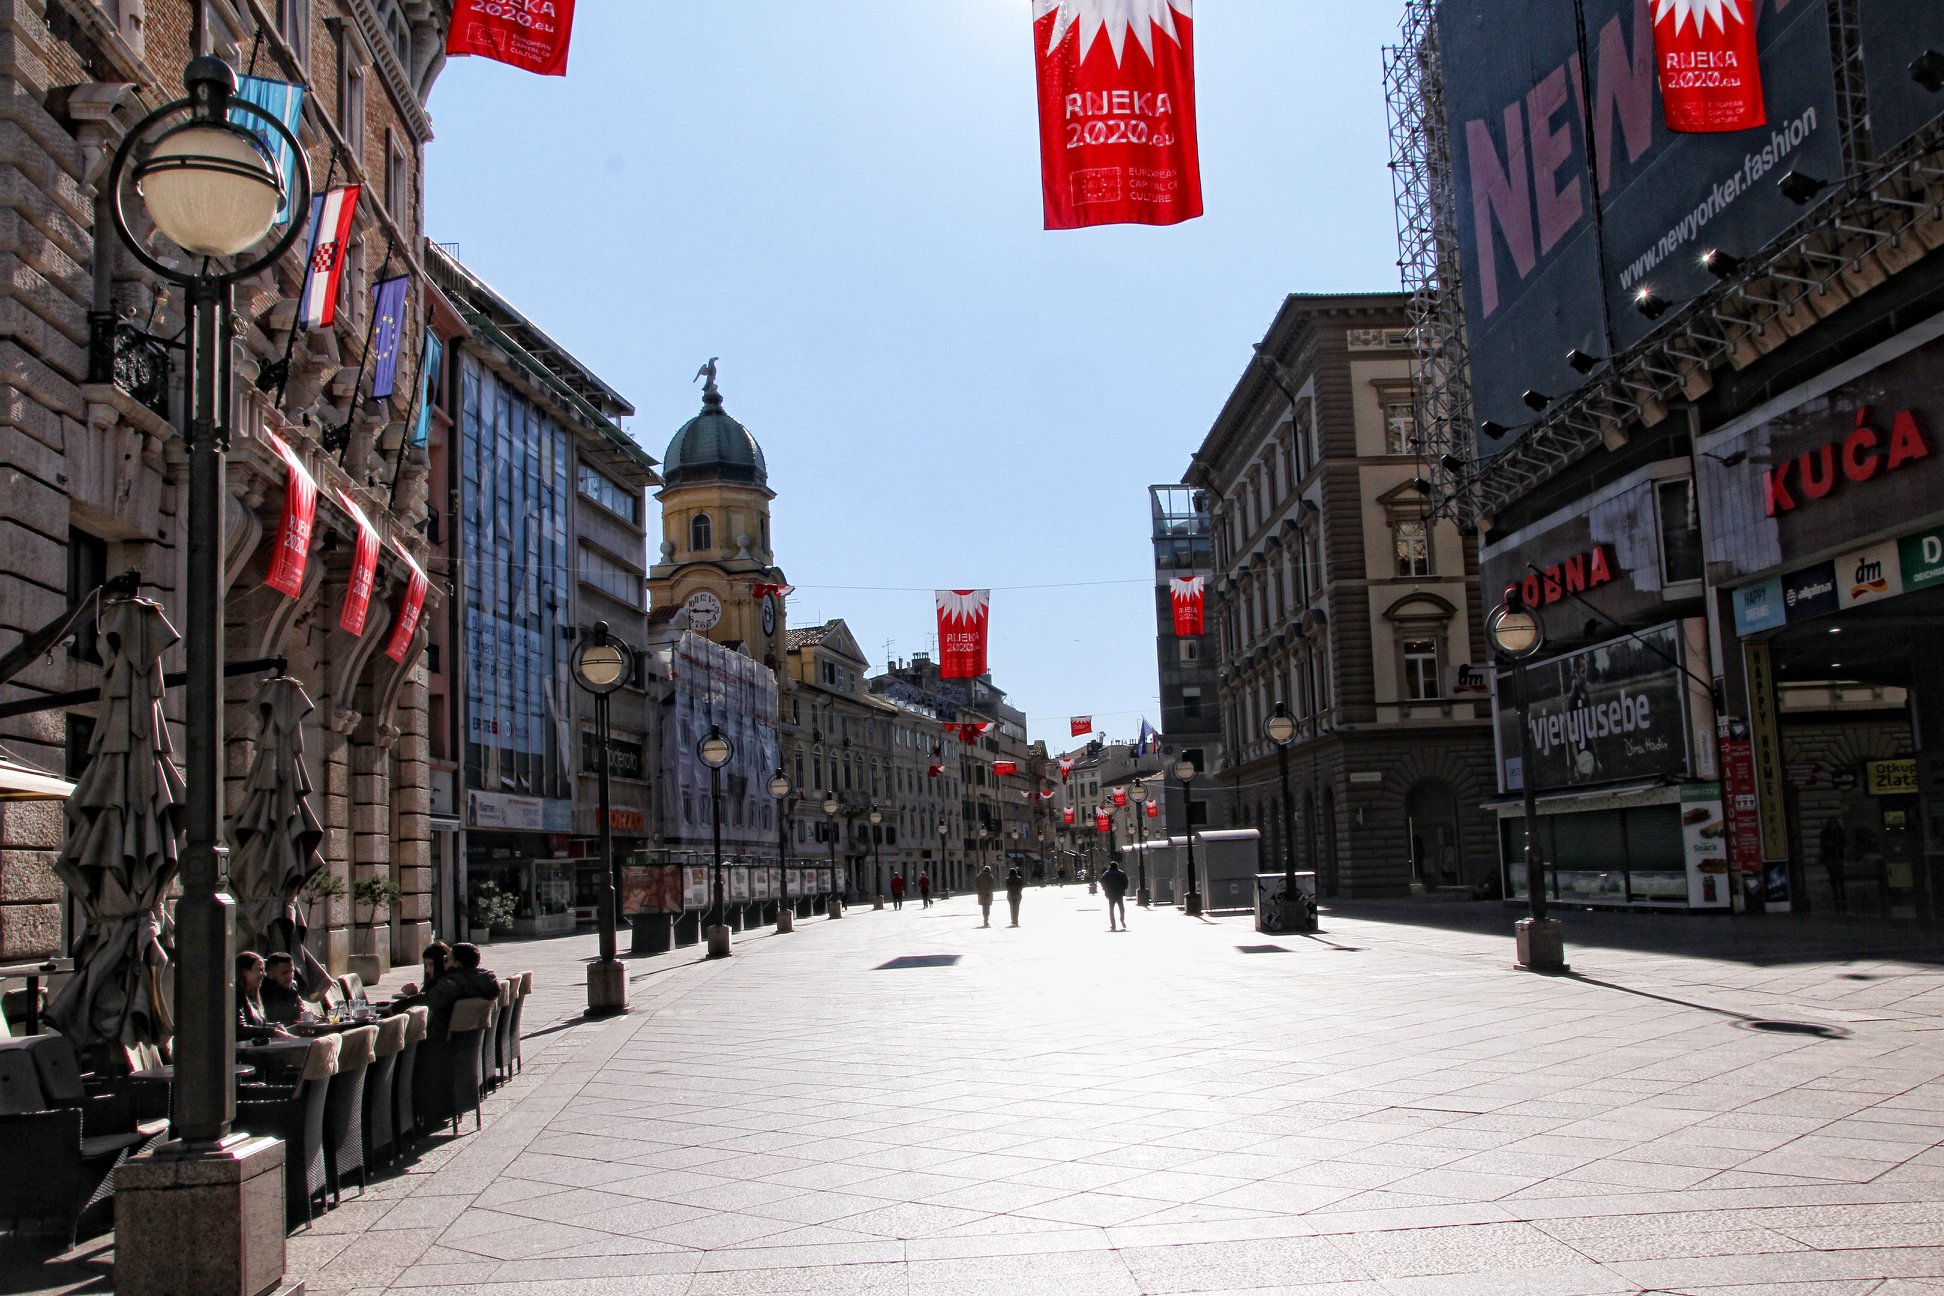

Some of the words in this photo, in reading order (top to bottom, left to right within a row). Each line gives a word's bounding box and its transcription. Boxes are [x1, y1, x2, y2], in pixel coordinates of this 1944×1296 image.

[1666, 50, 1739, 69] RIJEKA
[1667, 70, 1741, 88] 2020.eu
[1065, 90, 1172, 119] RIJEKA
[1066, 119, 1175, 149] 2020.eu
[1128, 167, 1177, 179] EUROPEAN
[1129, 191, 1172, 203] CULTURE
[1620, 105, 1818, 291] www.newyorker.fashion
[1763, 405, 1928, 517] KUĆA
[1922, 535, 1942, 563] D
[1855, 556, 1881, 584] dm
[700, 593, 707, 602] 12
[1744, 585, 1766, 608] HAPPY
[1797, 581, 1833, 600] alpina
[688, 599, 695, 608] 10
[714, 606, 720, 614] 3
[695, 620, 700, 628] 7
[700, 621, 706, 629] 6
[472, 716, 491, 734] ERTE
[1528, 689, 1650, 756] vjerujusebe
[1753, 651, 1766, 727] HAPPY
[1761, 735, 1774, 796] HOME
[1876, 762, 1918, 774] Otkup
